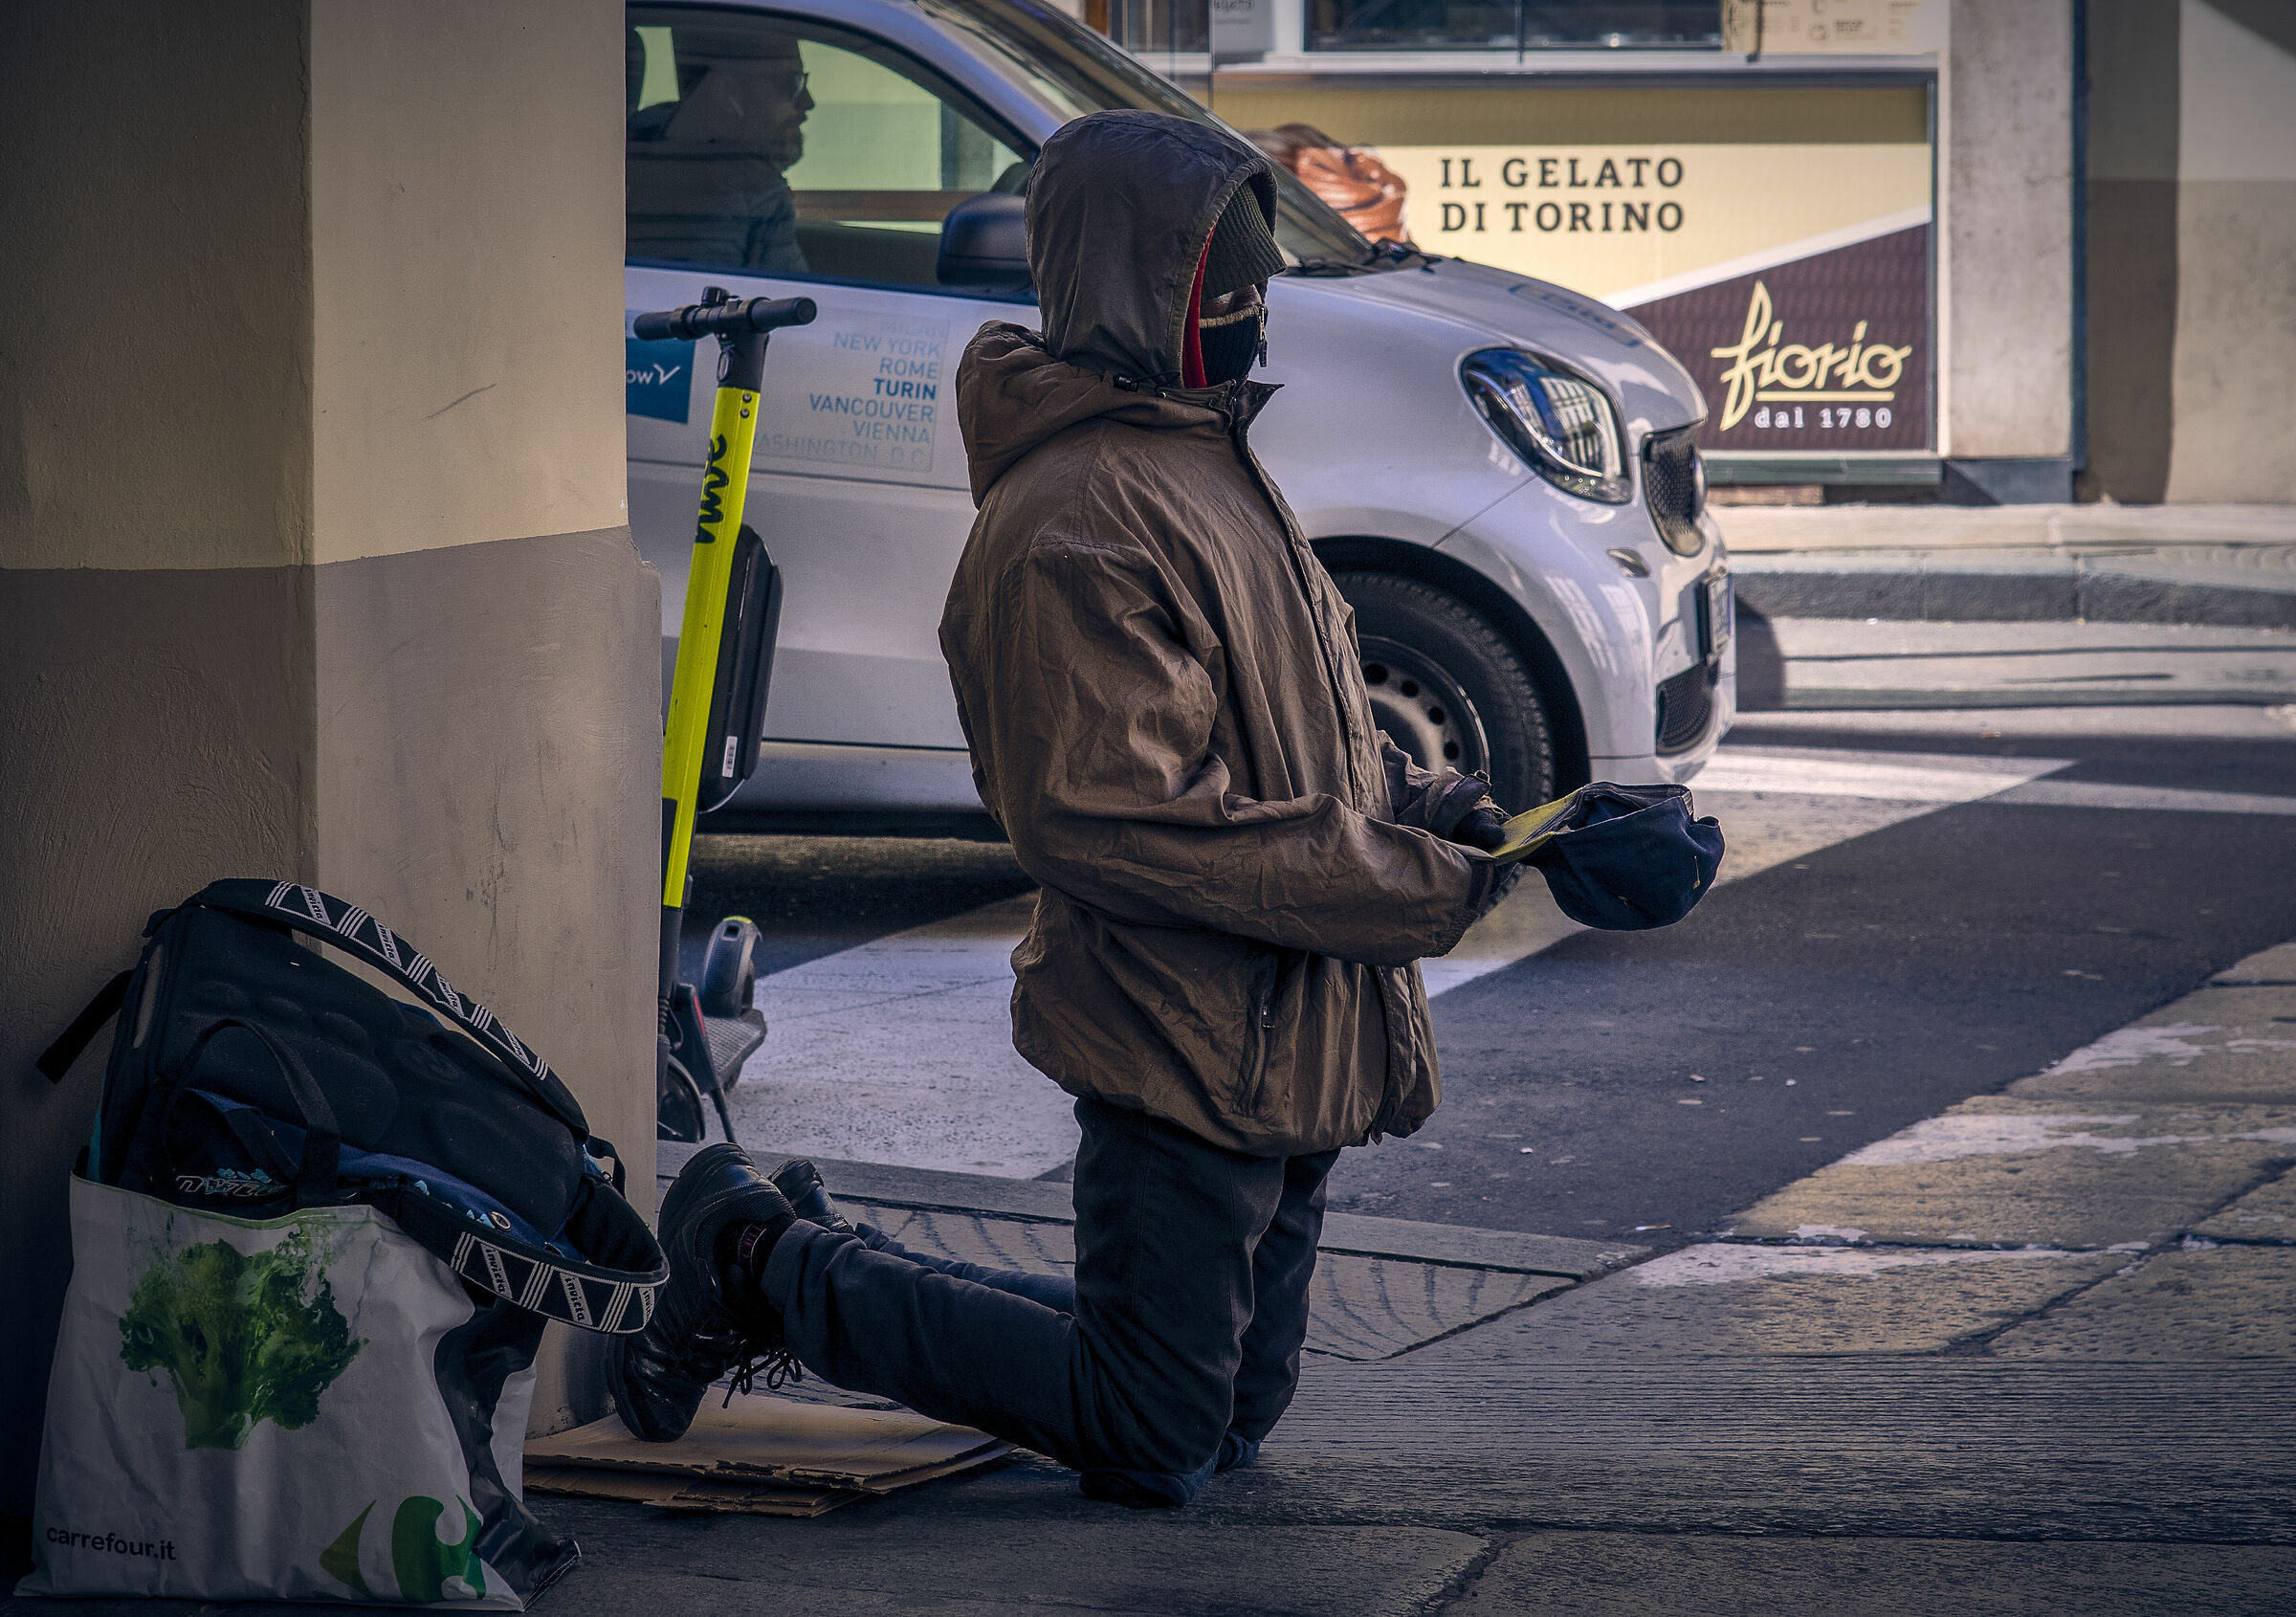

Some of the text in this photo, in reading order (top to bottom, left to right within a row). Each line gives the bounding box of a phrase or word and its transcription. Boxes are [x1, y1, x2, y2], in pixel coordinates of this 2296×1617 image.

[1441, 157, 1684, 188] IL GELATO
[1441, 201, 1684, 233] DI TORINO
[833, 331, 941, 359] NEW YORK
[1711, 279, 1912, 432] fiorio
[879, 356, 939, 380] ROME
[873, 377, 937, 401] TURIN
[809, 393, 935, 423] VANCOUVER
[1754, 406, 1892, 429] dal 1780
[752, 432, 878, 462] ASHINGTON
[853, 419, 931, 445] VIENNA
[47, 1526, 177, 1561] carrefour.it
